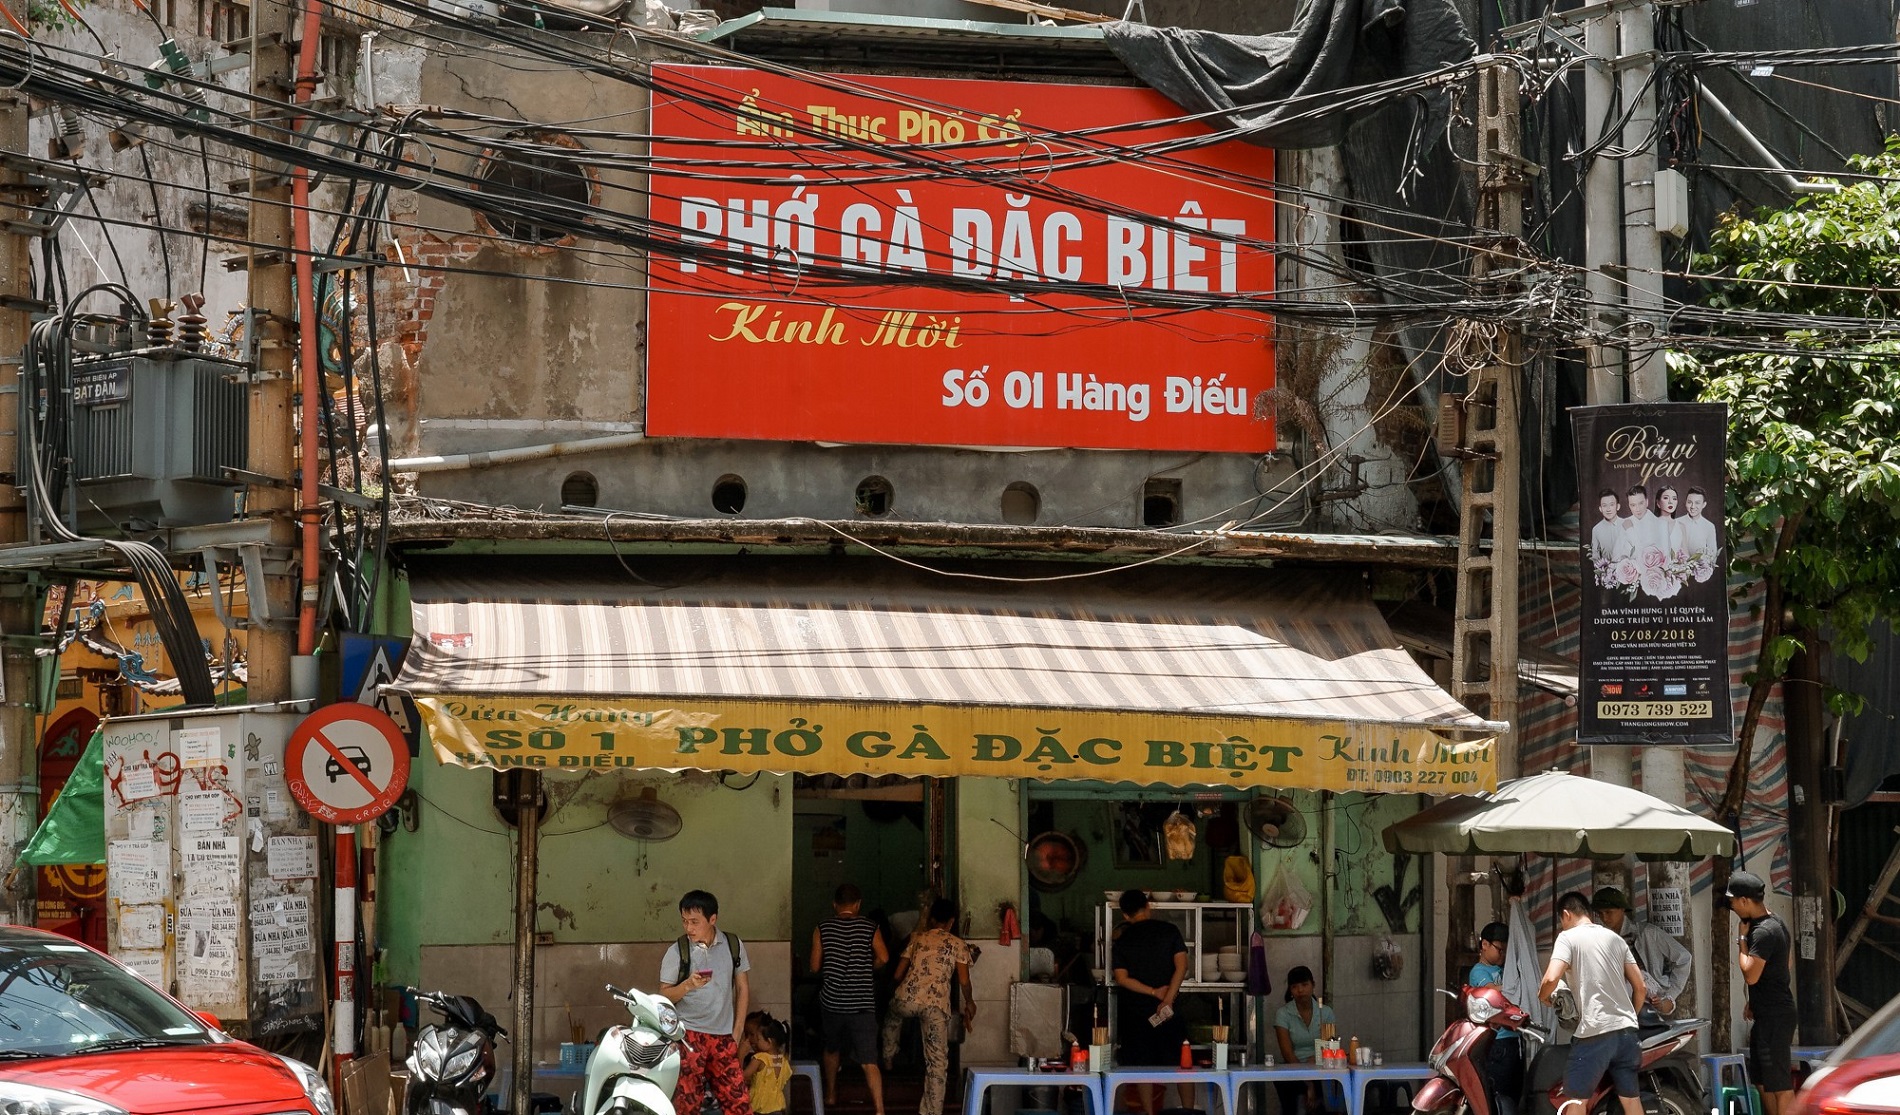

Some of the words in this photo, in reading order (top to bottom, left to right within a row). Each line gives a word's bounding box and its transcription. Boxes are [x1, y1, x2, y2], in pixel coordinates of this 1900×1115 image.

[840, 189, 928, 276] GÀ
[950, 192, 1083, 303] ĐẶC
[708, 302, 849, 345] Kính
[860, 310, 963, 349] Mời
[95, 381, 116, 397] ĐÀN
[942, 365, 990, 408] Số
[1056, 372, 1150, 422] Hàng
[1164, 373, 1248, 416] Điếu
[1671, 434, 1698, 460] vì
[1638, 457, 1685, 486] yêu
[1611, 629, 1695, 641] 05/08/2018
[1602, 703, 1640, 716] 0973
[1646, 703, 1674, 716] 739
[1680, 703, 1707, 716] 522
[558, 752, 635, 767] ĐIẾU
[591, 731, 615, 751] 1
[675, 718, 823, 757] PHỞ
[845, 725, 951, 760] GÀ
[970, 727, 1123, 771] ĐẶC
[1144, 735, 1303, 778] BIỆT
[1417, 771, 1447, 785] 227
